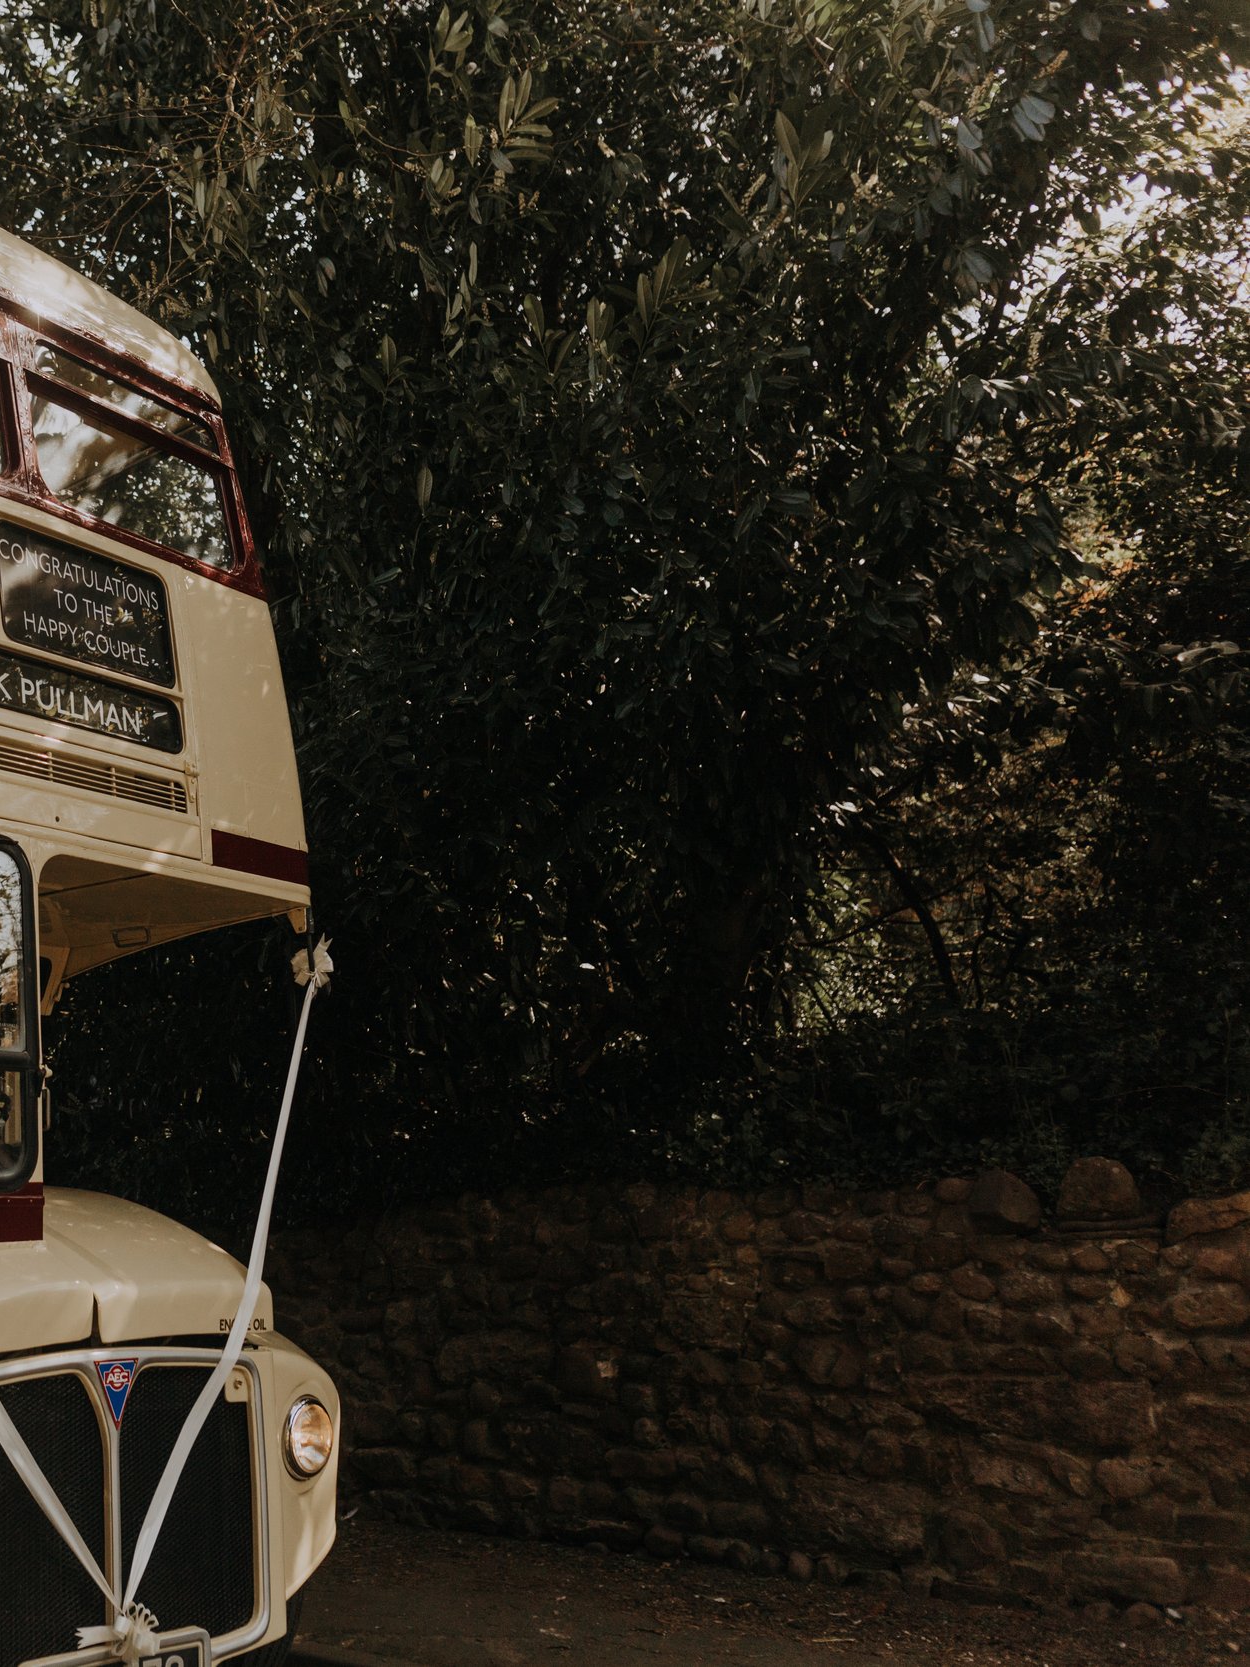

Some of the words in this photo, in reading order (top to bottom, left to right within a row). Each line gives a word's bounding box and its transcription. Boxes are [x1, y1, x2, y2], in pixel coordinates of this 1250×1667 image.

[53, 589, 78, 613] TO
[82, 598, 114, 626] THE
[23, 611, 78, 644] HAPPY
[84, 630, 149, 667] COUPLE
[21, 677, 141, 735] PULLMAN
[253, 1318, 267, 1331] OIL
[106, 1372, 128, 1384] AEC
